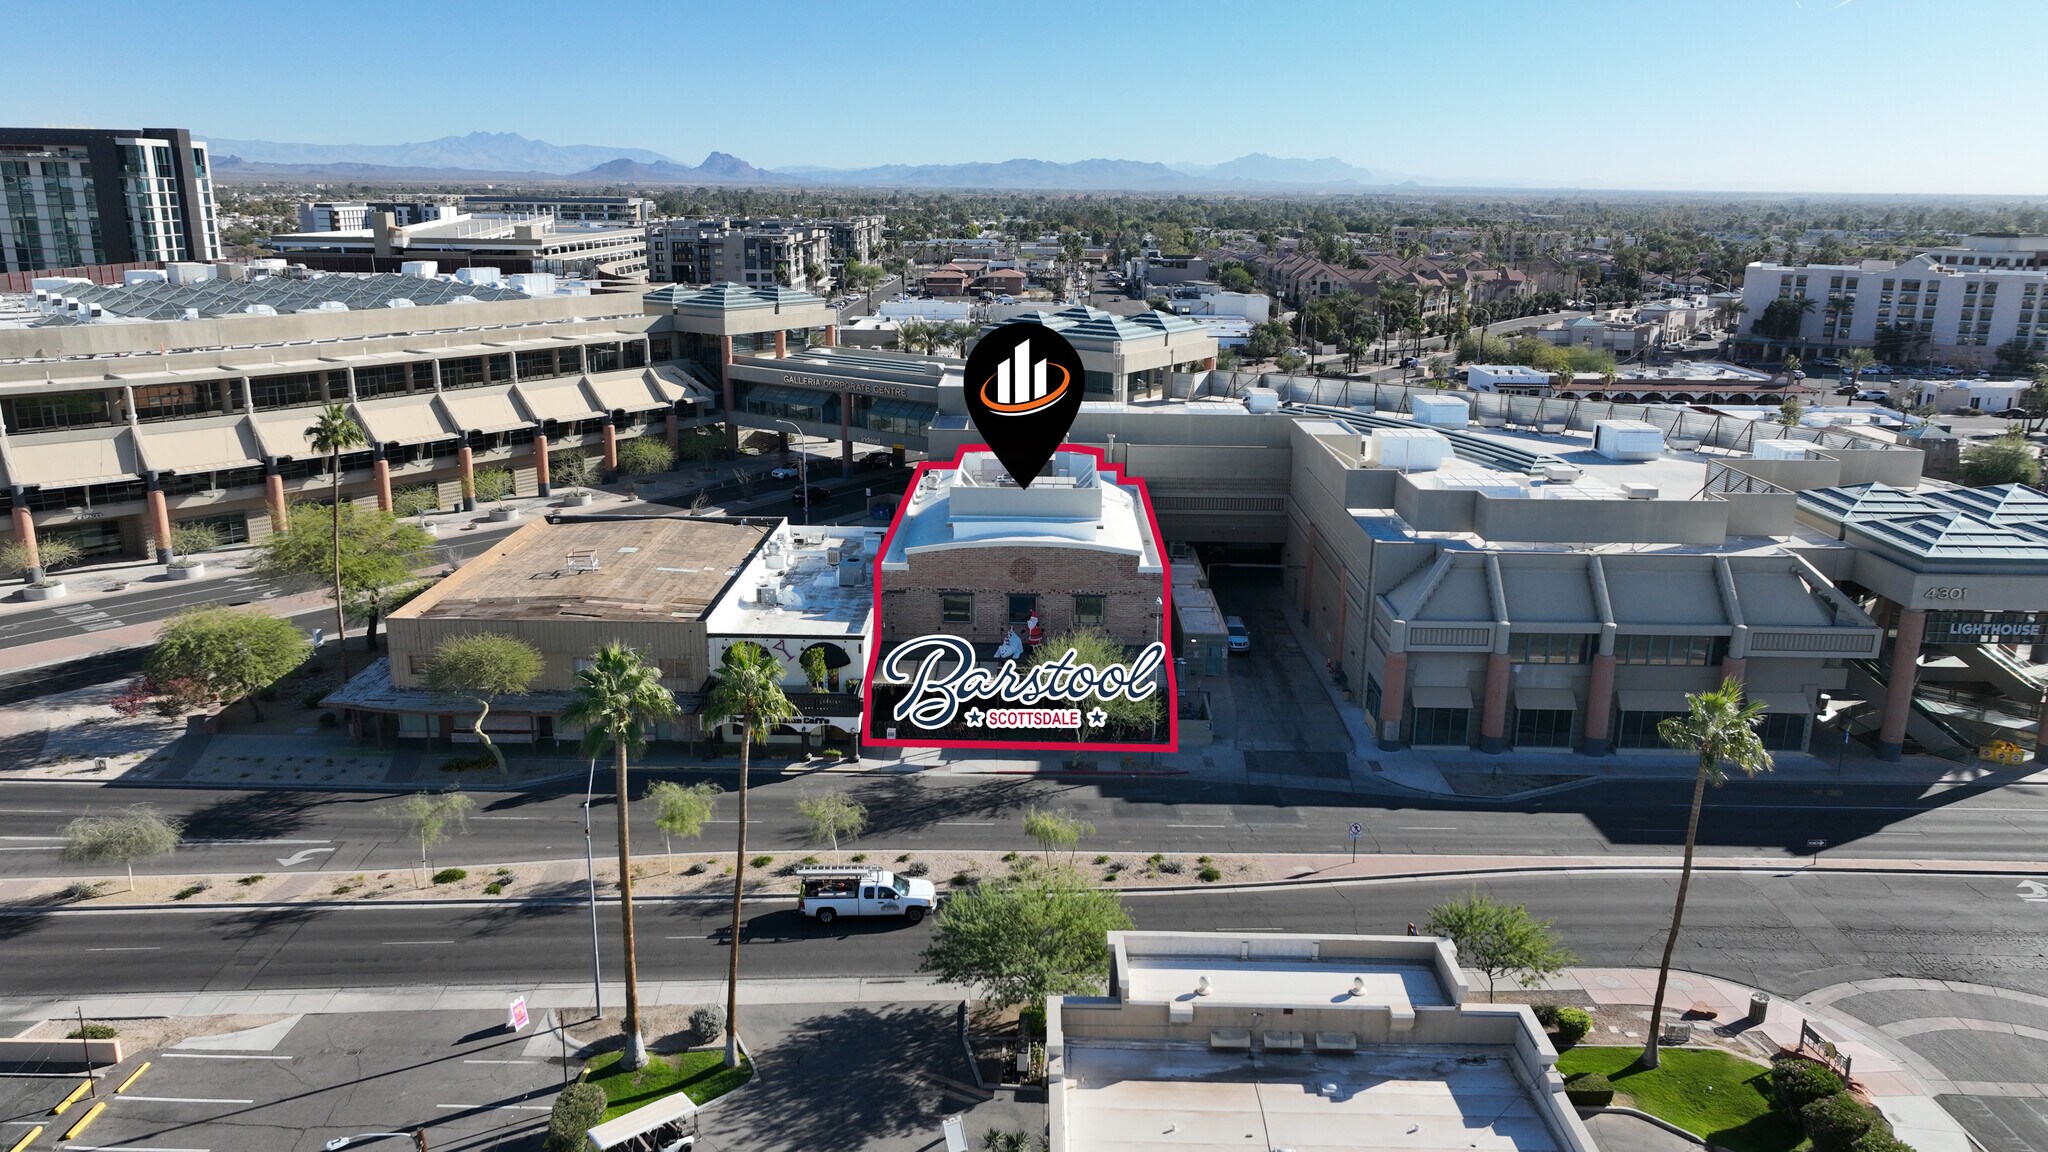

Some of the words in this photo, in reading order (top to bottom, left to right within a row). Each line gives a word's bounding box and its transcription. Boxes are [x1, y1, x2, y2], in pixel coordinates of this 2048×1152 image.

[783, 375, 821, 386] GALLERIA
[823, 379, 871, 393] CORPORATE
[873, 385, 907, 397] CENTRE
[1924, 587, 1968, 600] 4301
[1950, 623, 2040, 635] LIGHTHOUSE
